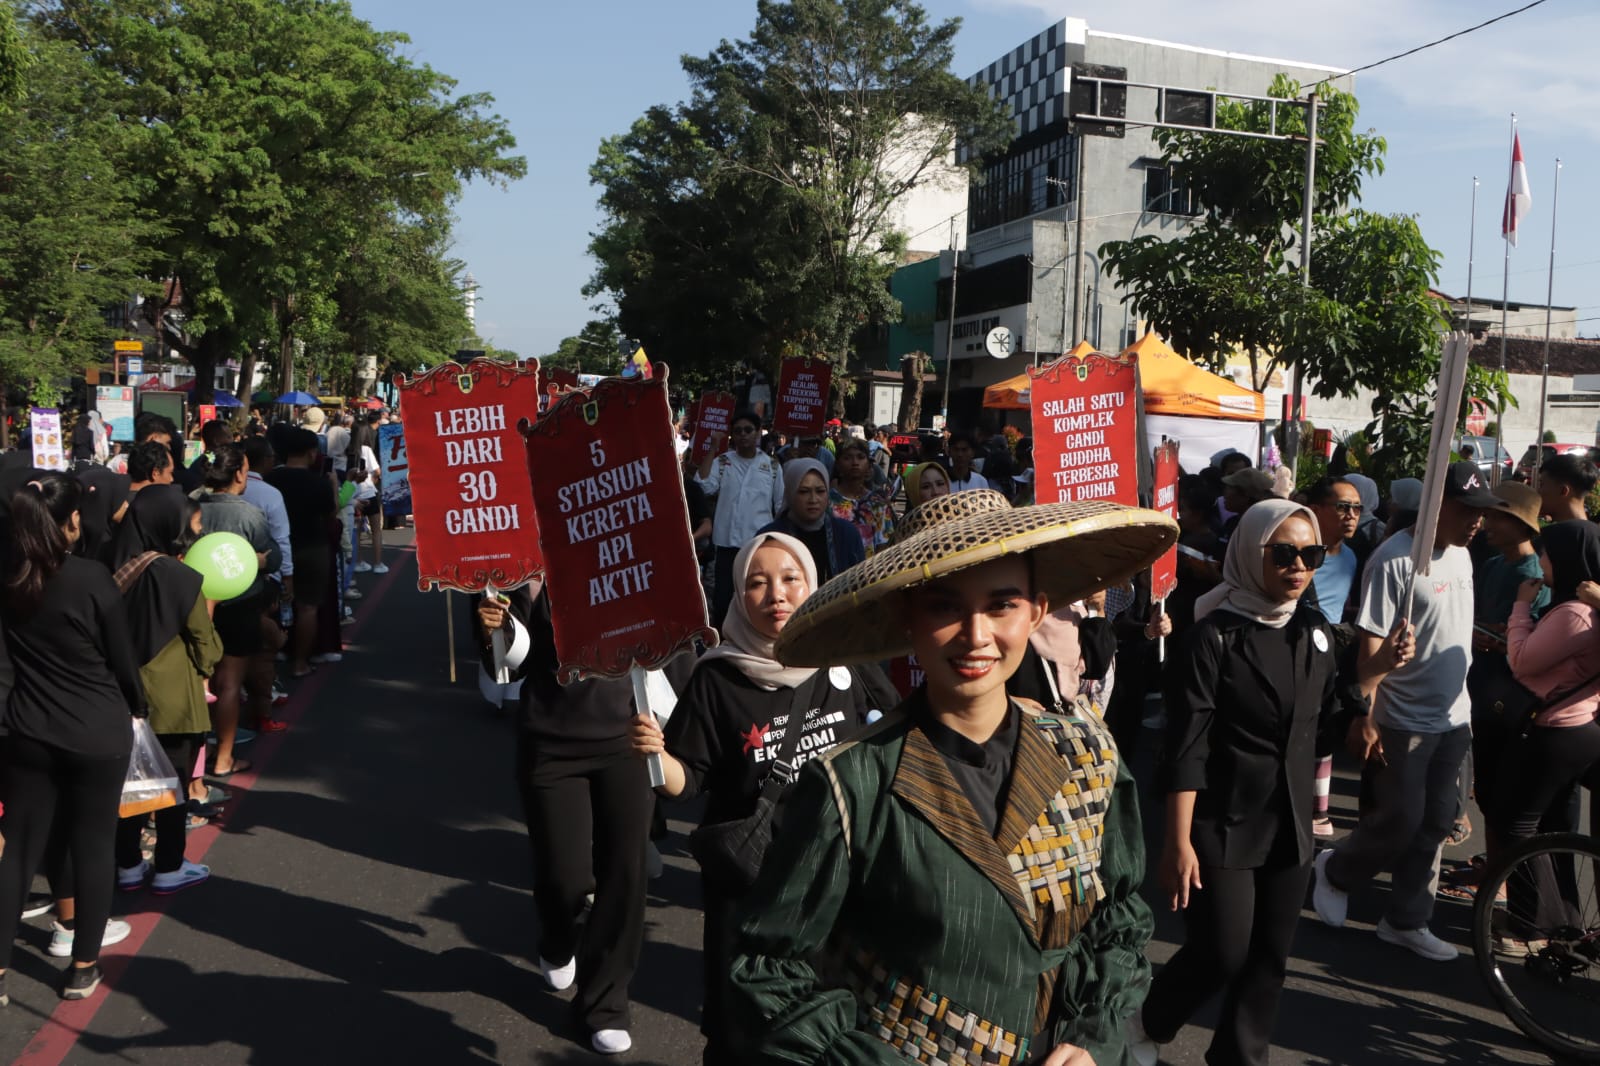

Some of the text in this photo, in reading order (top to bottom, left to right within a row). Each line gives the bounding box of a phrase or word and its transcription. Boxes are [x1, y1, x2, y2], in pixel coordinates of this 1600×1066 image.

[1043, 391, 1125, 417] SALAH SATU
[435, 404, 506, 436] LEBIH
[1053, 410, 1115, 434] KOMPLEK
[445, 436, 503, 467] DARI
[589, 439, 606, 467] 5
[1066, 429, 1105, 449] CANDI
[1060, 446, 1112, 468] BUDDHA
[458, 470, 498, 503] 30
[557, 456, 653, 513] STASIUN
[1053, 462, 1120, 487] TERBESAR
[1058, 480, 1116, 504] DI DUNIA
[445, 503, 520, 535] CANDI
[566, 492, 654, 545] KERETA
[598, 532, 635, 569] API
[589, 560, 654, 607] AKTIF
